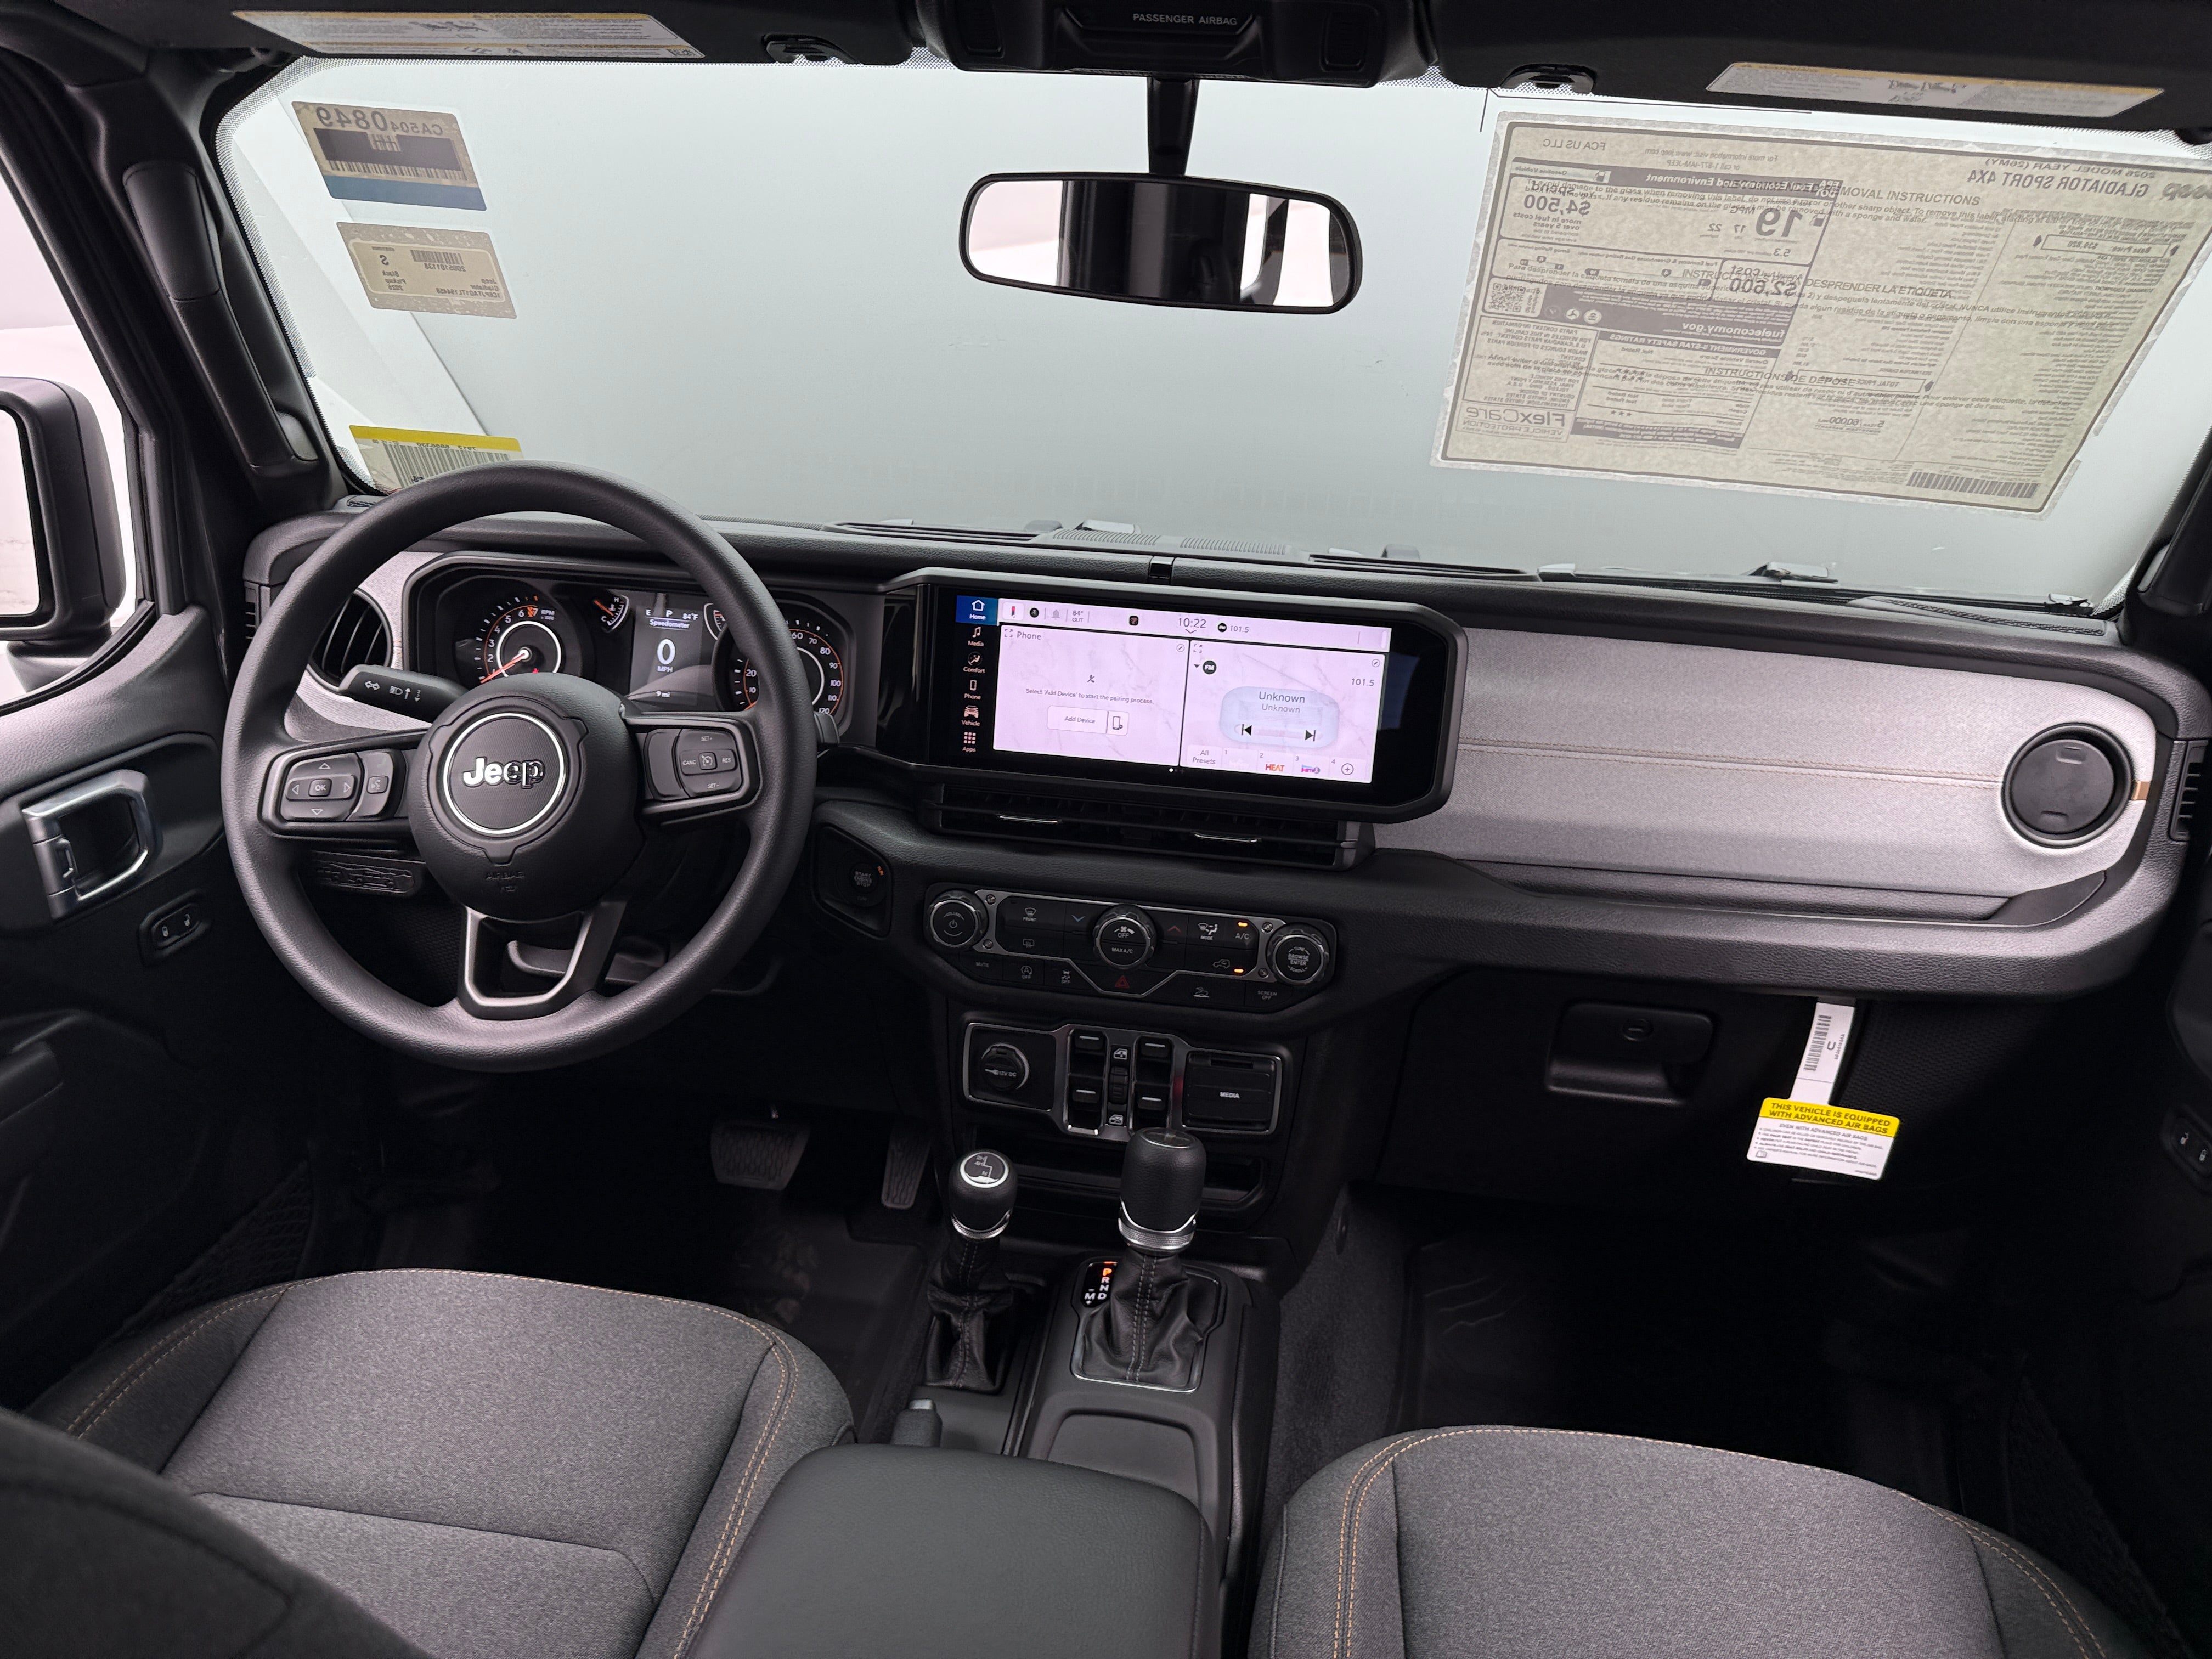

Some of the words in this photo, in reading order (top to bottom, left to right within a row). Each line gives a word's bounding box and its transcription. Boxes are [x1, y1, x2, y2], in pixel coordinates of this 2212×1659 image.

[1132, 13, 1194, 25] PASSENGER
[1198, 16, 1237, 26] AIRBAG
[1667, 190, 1706, 201] removing
[1858, 205, 1882, 213] sharp
[1887, 190, 1981, 206] INSTRUCTIONS
[1852, 212, 1883, 222] sponge
[1508, 263, 1526, 271] Para
[1527, 265, 1570, 276] desprender
[1871, 297, 1914, 306] lentamente
[1806, 279, 1882, 294] DESPRENDER
[1882, 286, 1897, 294] LA
[1898, 286, 1953, 299] ETIQUETA
[1705, 366, 1788, 381] INSTRUCTIONS
[518, 609, 524, 618] 6
[532, 608, 539, 616] 7
[504, 615, 512, 623] 5
[649, 618, 690, 628] Speedometer
[1178, 617, 1206, 629] 10:22
[494, 625, 501, 634] 4
[791, 631, 804, 640] 60
[1017, 631, 1042, 640] Phone
[488, 639, 495, 648] 3
[657, 638, 676, 665] 0
[819, 647, 831, 655] 80
[487, 654, 493, 663] 2
[746, 669, 757, 677] 20
[1351, 678, 1375, 687] 101.5
[1109, 695, 1130, 703] pairing
[1259, 691, 1305, 703] Unknown
[1261, 703, 1300, 714] Unknown
[961, 719, 980, 727] Vehicle
[1192, 757, 1216, 765] Presets
[1265, 763, 1285, 772] HEAT
[462, 756, 546, 789] Jeep
[1235, 932, 1250, 940] A/C
[1219, 1091, 1241, 1099] MEDIA
[1771, 1102, 1792, 1111] THIS
[1793, 1105, 1831, 1117] VEHICLE
[1843, 1113, 1891, 1127] EQUIPPED
[1769, 1109, 1792, 1119] WITH
[1793, 1113, 1844, 1127] ADVANCED
[1844, 1120, 1862, 1130] AIR
[1863, 1124, 1888, 1135] BAGS
[1810, 1126, 1841, 1136] ADVANCED
[1102, 1268, 1113, 1276] P
[1099, 1284, 1109, 1292] N
[1084, 1292, 1096, 1301] M
[1097, 1292, 1108, 1301] D
